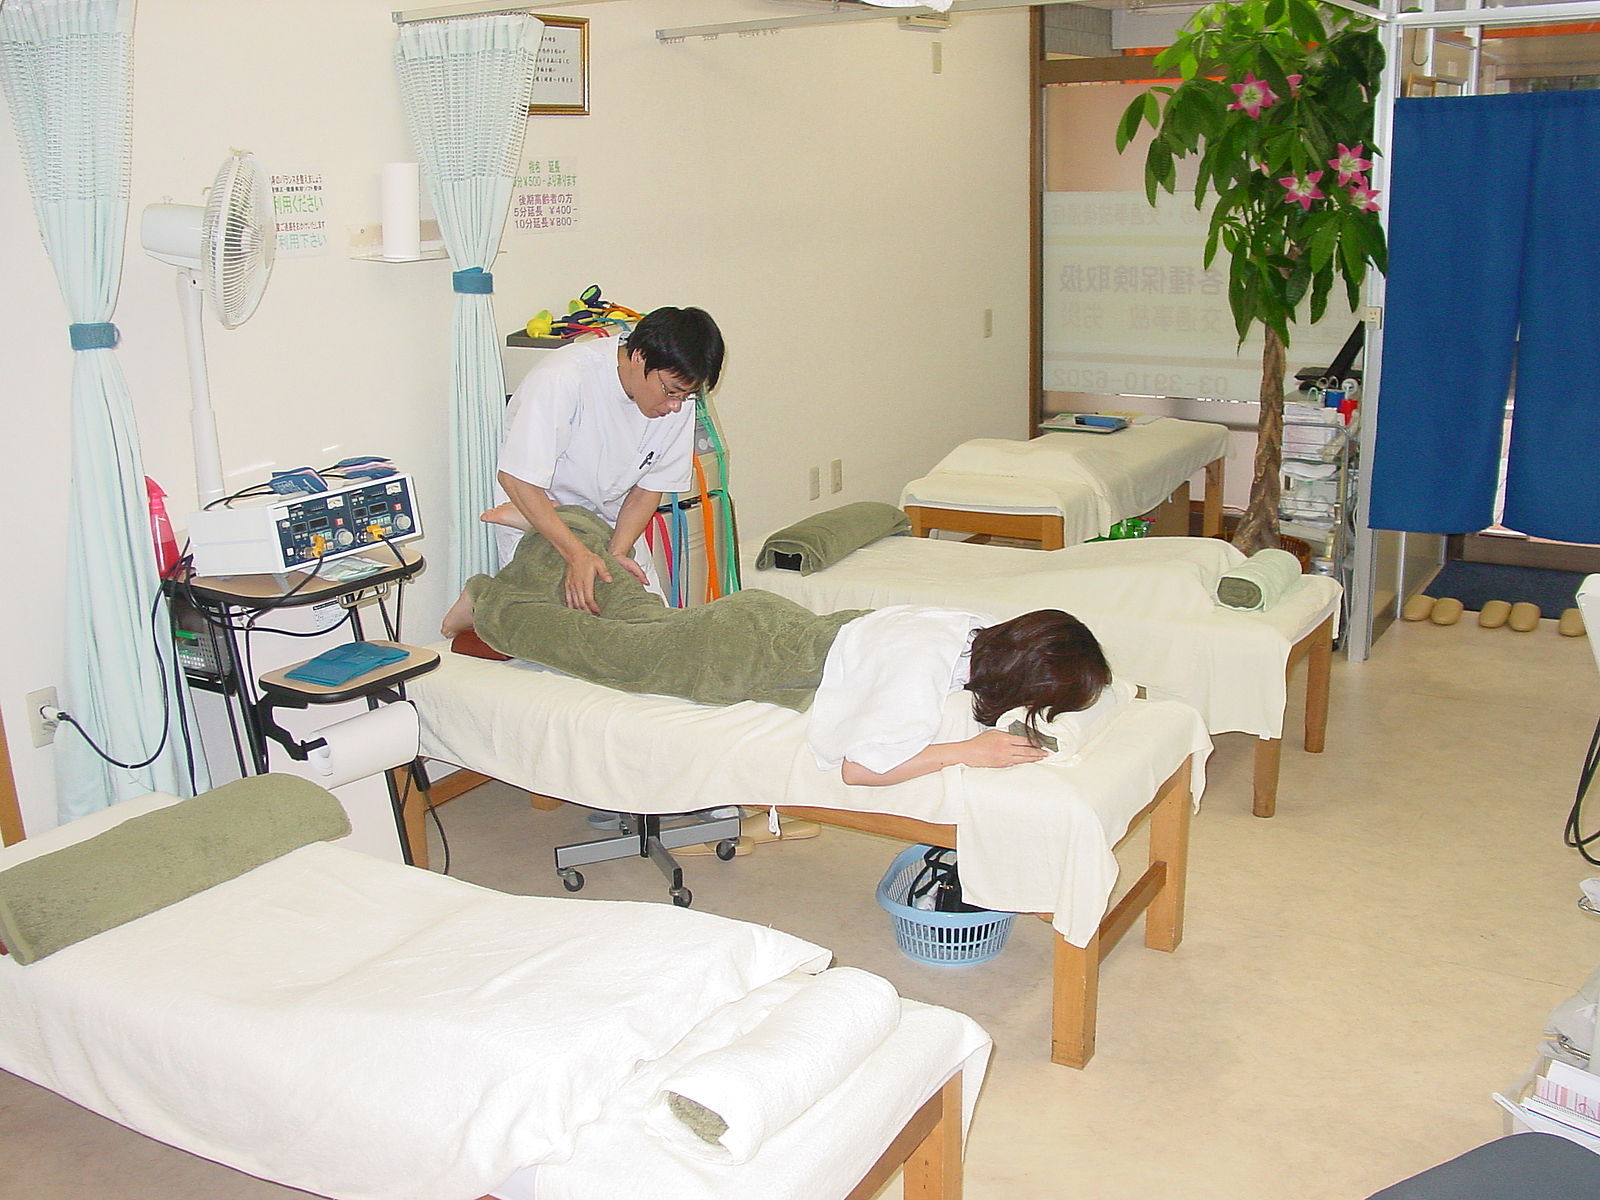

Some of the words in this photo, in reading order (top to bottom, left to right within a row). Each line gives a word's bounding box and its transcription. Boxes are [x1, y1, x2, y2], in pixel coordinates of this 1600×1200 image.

[518, 193, 574, 207] 後期高齢者の方
[513, 206, 544, 218] 5分延長
